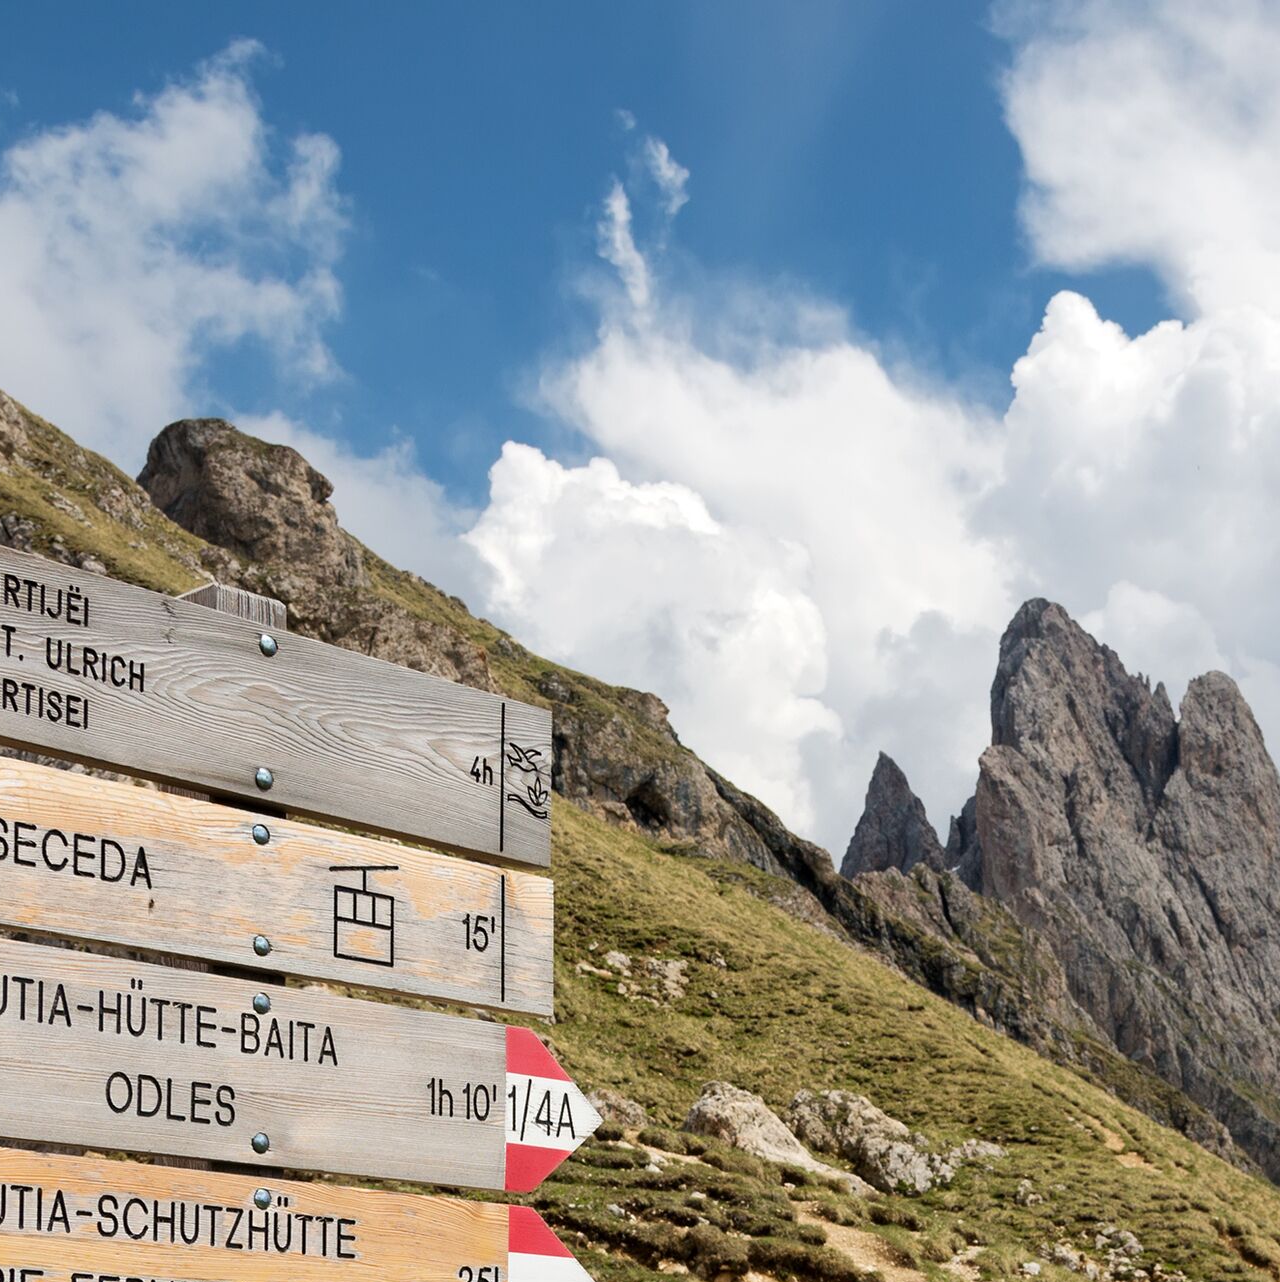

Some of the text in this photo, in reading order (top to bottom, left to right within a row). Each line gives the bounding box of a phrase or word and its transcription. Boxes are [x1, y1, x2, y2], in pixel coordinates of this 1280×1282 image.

[45, 636, 146, 693] ULRICH
[469, 755, 494, 786] 4h
[461, 912, 496, 953] 15'
[104, 1071, 237, 1127] ODLES
[426, 1077, 497, 1122] 1h 10'
[507, 1078, 576, 1142] 1/4A
